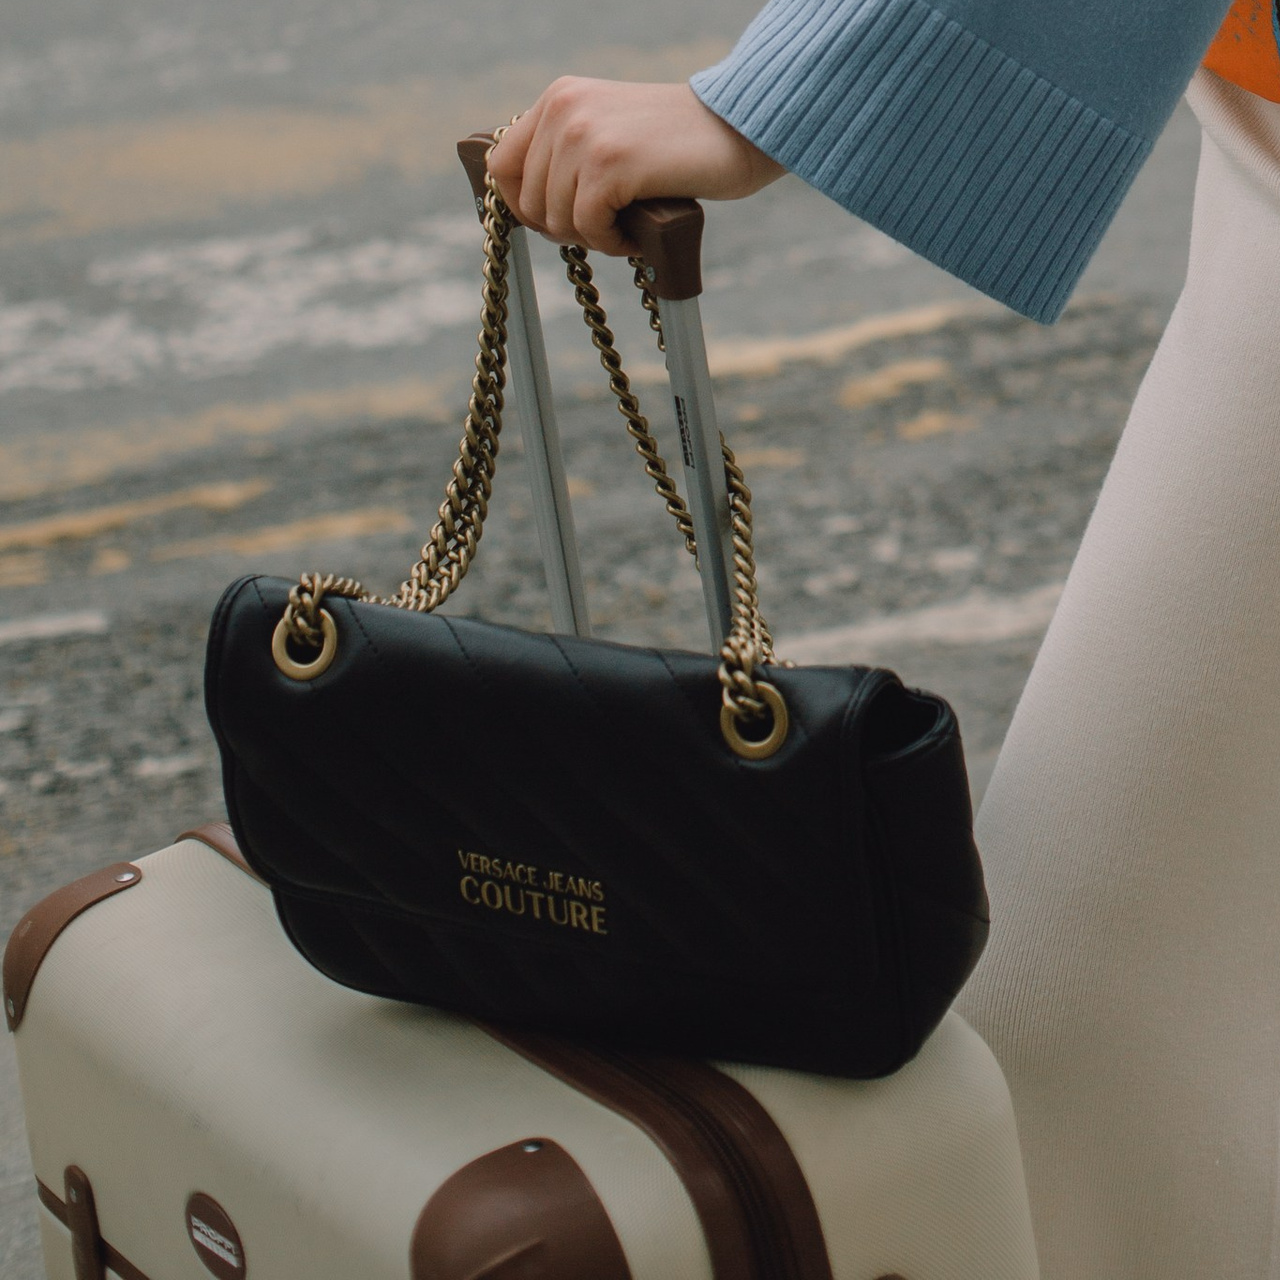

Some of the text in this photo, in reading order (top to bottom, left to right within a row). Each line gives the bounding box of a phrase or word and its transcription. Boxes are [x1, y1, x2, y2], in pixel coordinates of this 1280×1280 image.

[457, 849, 604, 902] VERSACE JEANS
[459, 875, 608, 935] COUTURE
